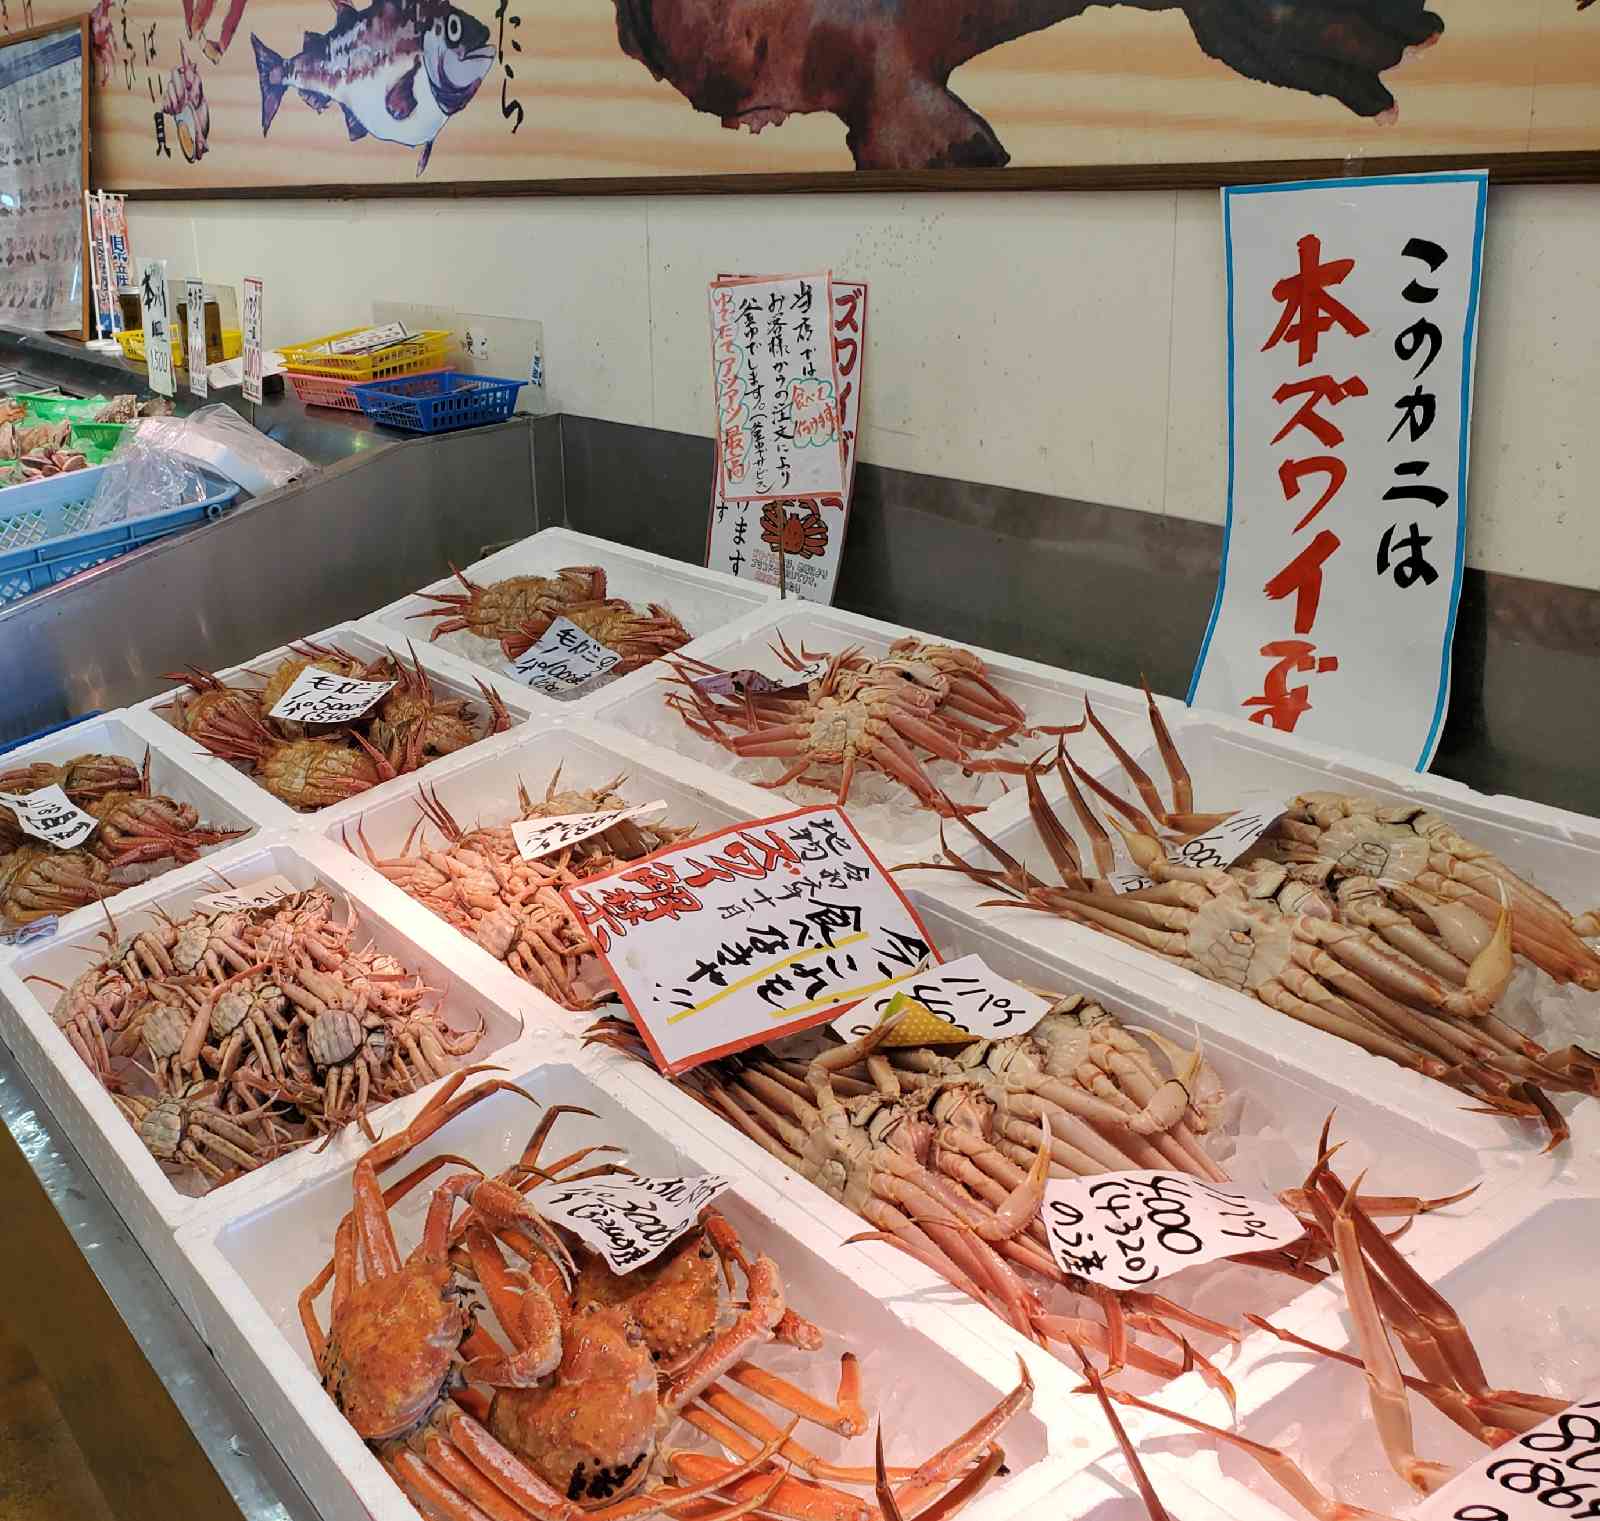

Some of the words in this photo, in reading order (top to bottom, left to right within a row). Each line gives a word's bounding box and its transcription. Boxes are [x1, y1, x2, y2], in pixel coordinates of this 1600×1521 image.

[790, 280, 818, 376] 当店では
[1376, 237, 1449, 588] このカニは
[1241, 233, 1370, 733] 本ズワイです
[1090, 1182, 1160, 1285] (4320)
